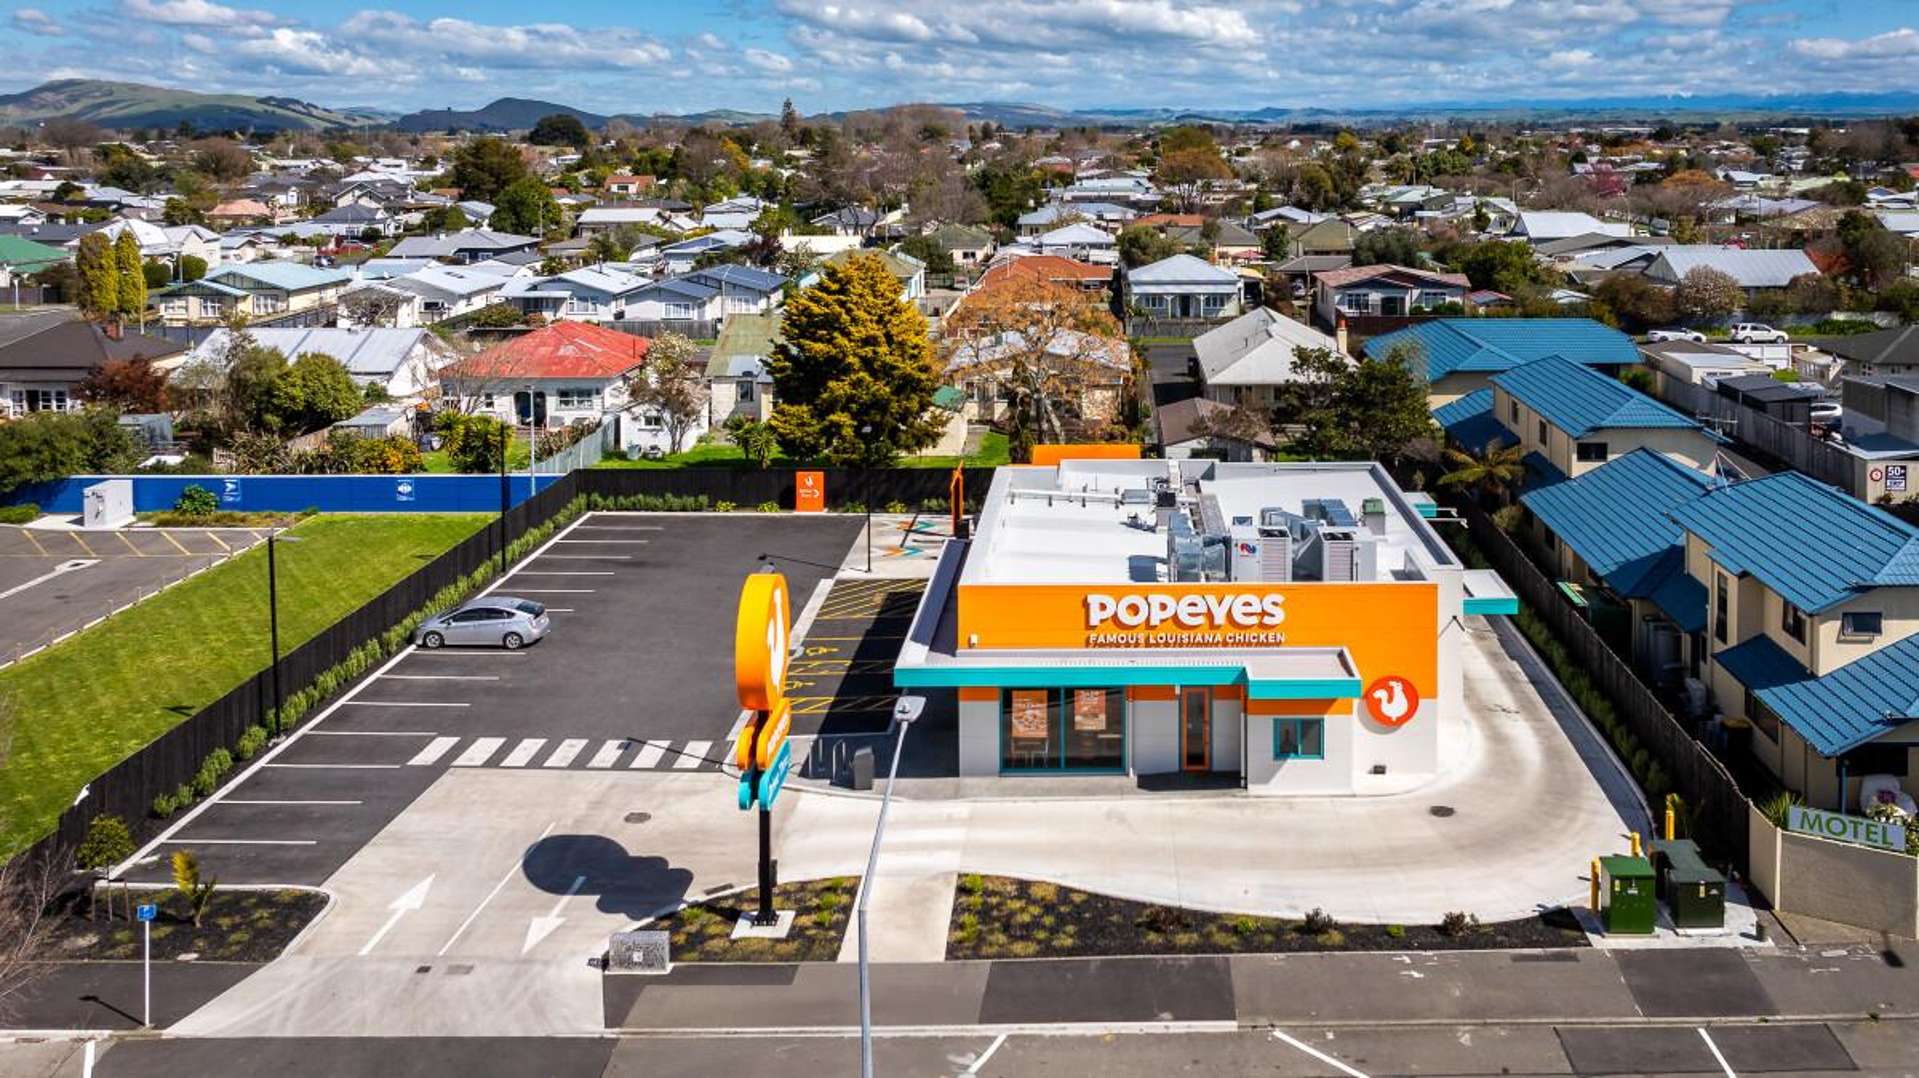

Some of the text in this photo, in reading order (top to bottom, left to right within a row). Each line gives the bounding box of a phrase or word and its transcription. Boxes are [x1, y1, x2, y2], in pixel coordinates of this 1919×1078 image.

[1089, 632, 1285, 644] FAMOUS LOUISIANA CHICKEN
[1800, 810, 1894, 846] MOTEL
